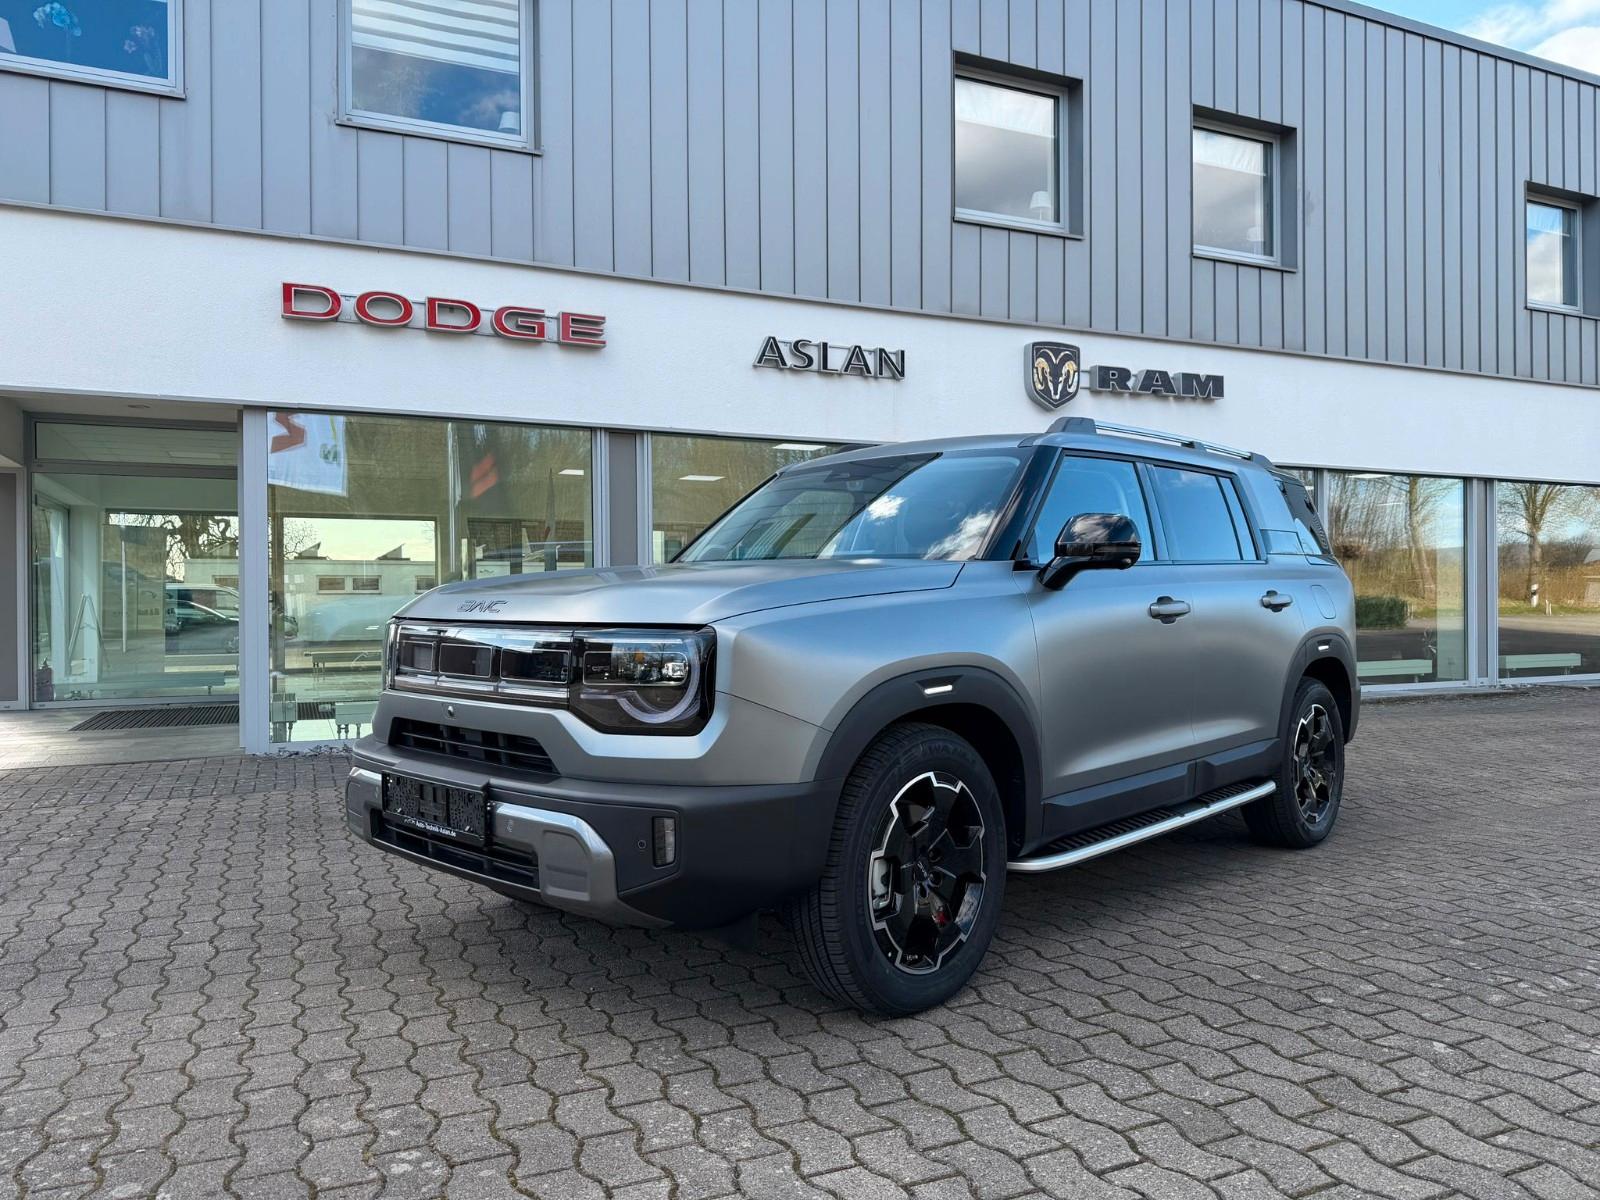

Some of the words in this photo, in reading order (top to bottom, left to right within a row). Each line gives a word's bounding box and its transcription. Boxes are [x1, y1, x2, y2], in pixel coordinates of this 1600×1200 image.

[281, 282, 607, 349] DODGE
[753, 335, 906, 380] ASLAN
[1090, 364, 1225, 401] RAM
